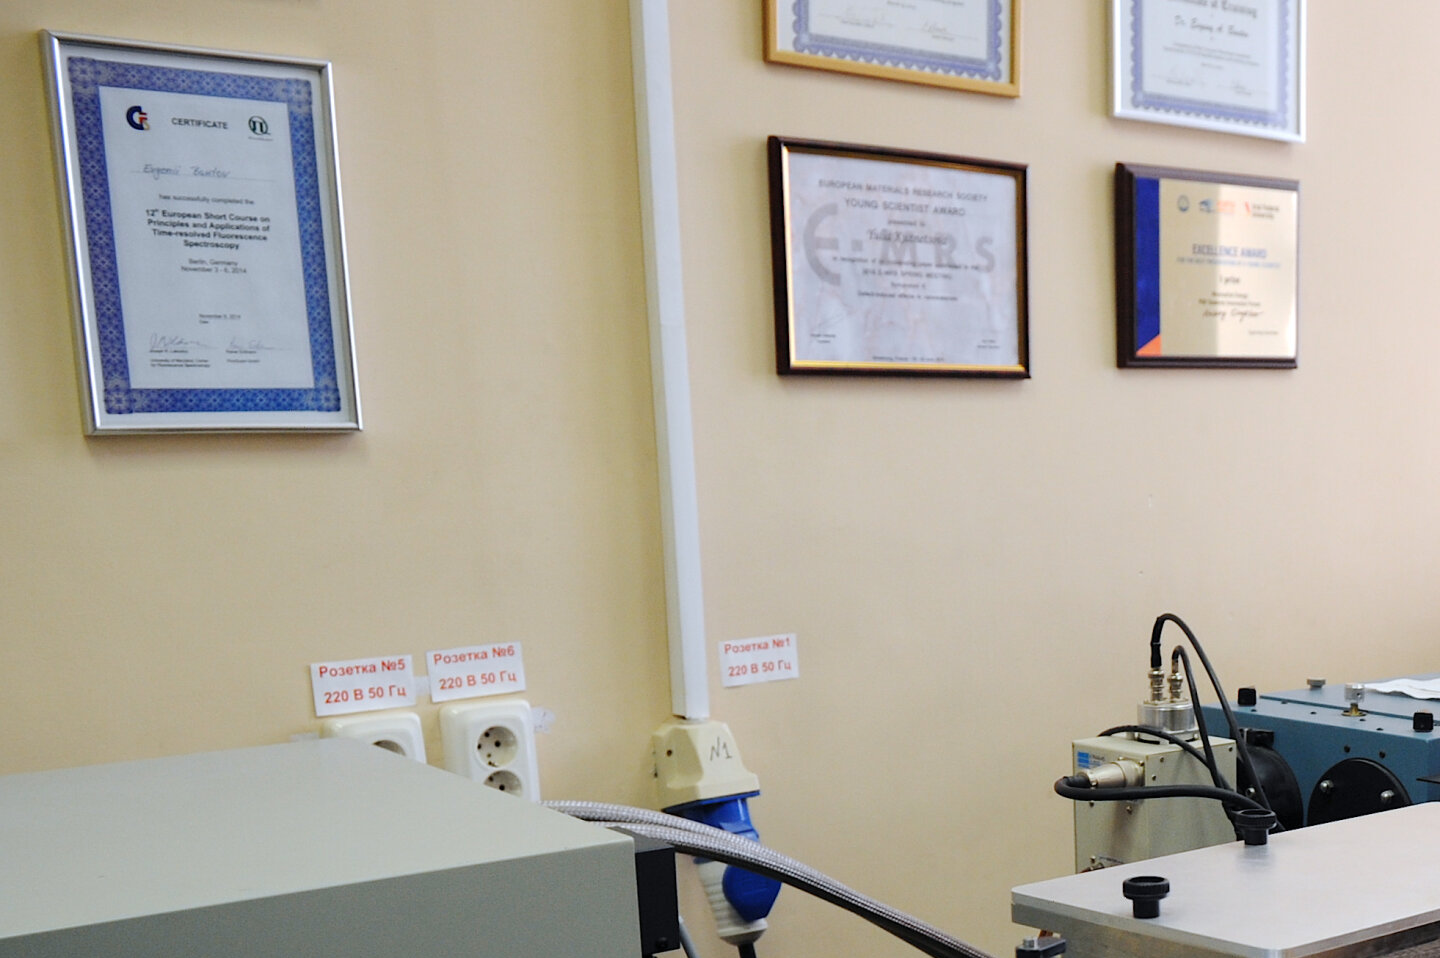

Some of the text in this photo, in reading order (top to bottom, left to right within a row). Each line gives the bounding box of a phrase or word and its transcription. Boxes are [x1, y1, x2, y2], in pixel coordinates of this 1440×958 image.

[171, 117, 228, 130] CERTIFICATE
[818, 179, 863, 191] EUROPEAN
[845, 198, 965, 217] YOUNG SCIENTIST AWARD
[161, 209, 202, 219] European
[204, 212, 227, 221] Short
[229, 213, 258, 222] Course
[147, 218, 189, 229] Principles
[192, 221, 207, 229] and
[209, 222, 260, 231] Applications
[152, 228, 268, 241] Time-resolved Fluorescence
[183, 239, 239, 250] Spectroscopy
[724, 641, 769, 654] Розетка
[433, 645, 515, 665] Розетка №6
[319, 658, 406, 678] Розетка №5
[728, 665, 748, 677] 220
[762, 661, 775, 672] 50
[778, 660, 792, 670] Гц
[439, 677, 463, 690] 220
[481, 672, 496, 684] 50
[500, 670, 517, 683] Гц
[324, 692, 349, 704] 220
[369, 687, 384, 699] 50
[389, 685, 406, 697] Гц
